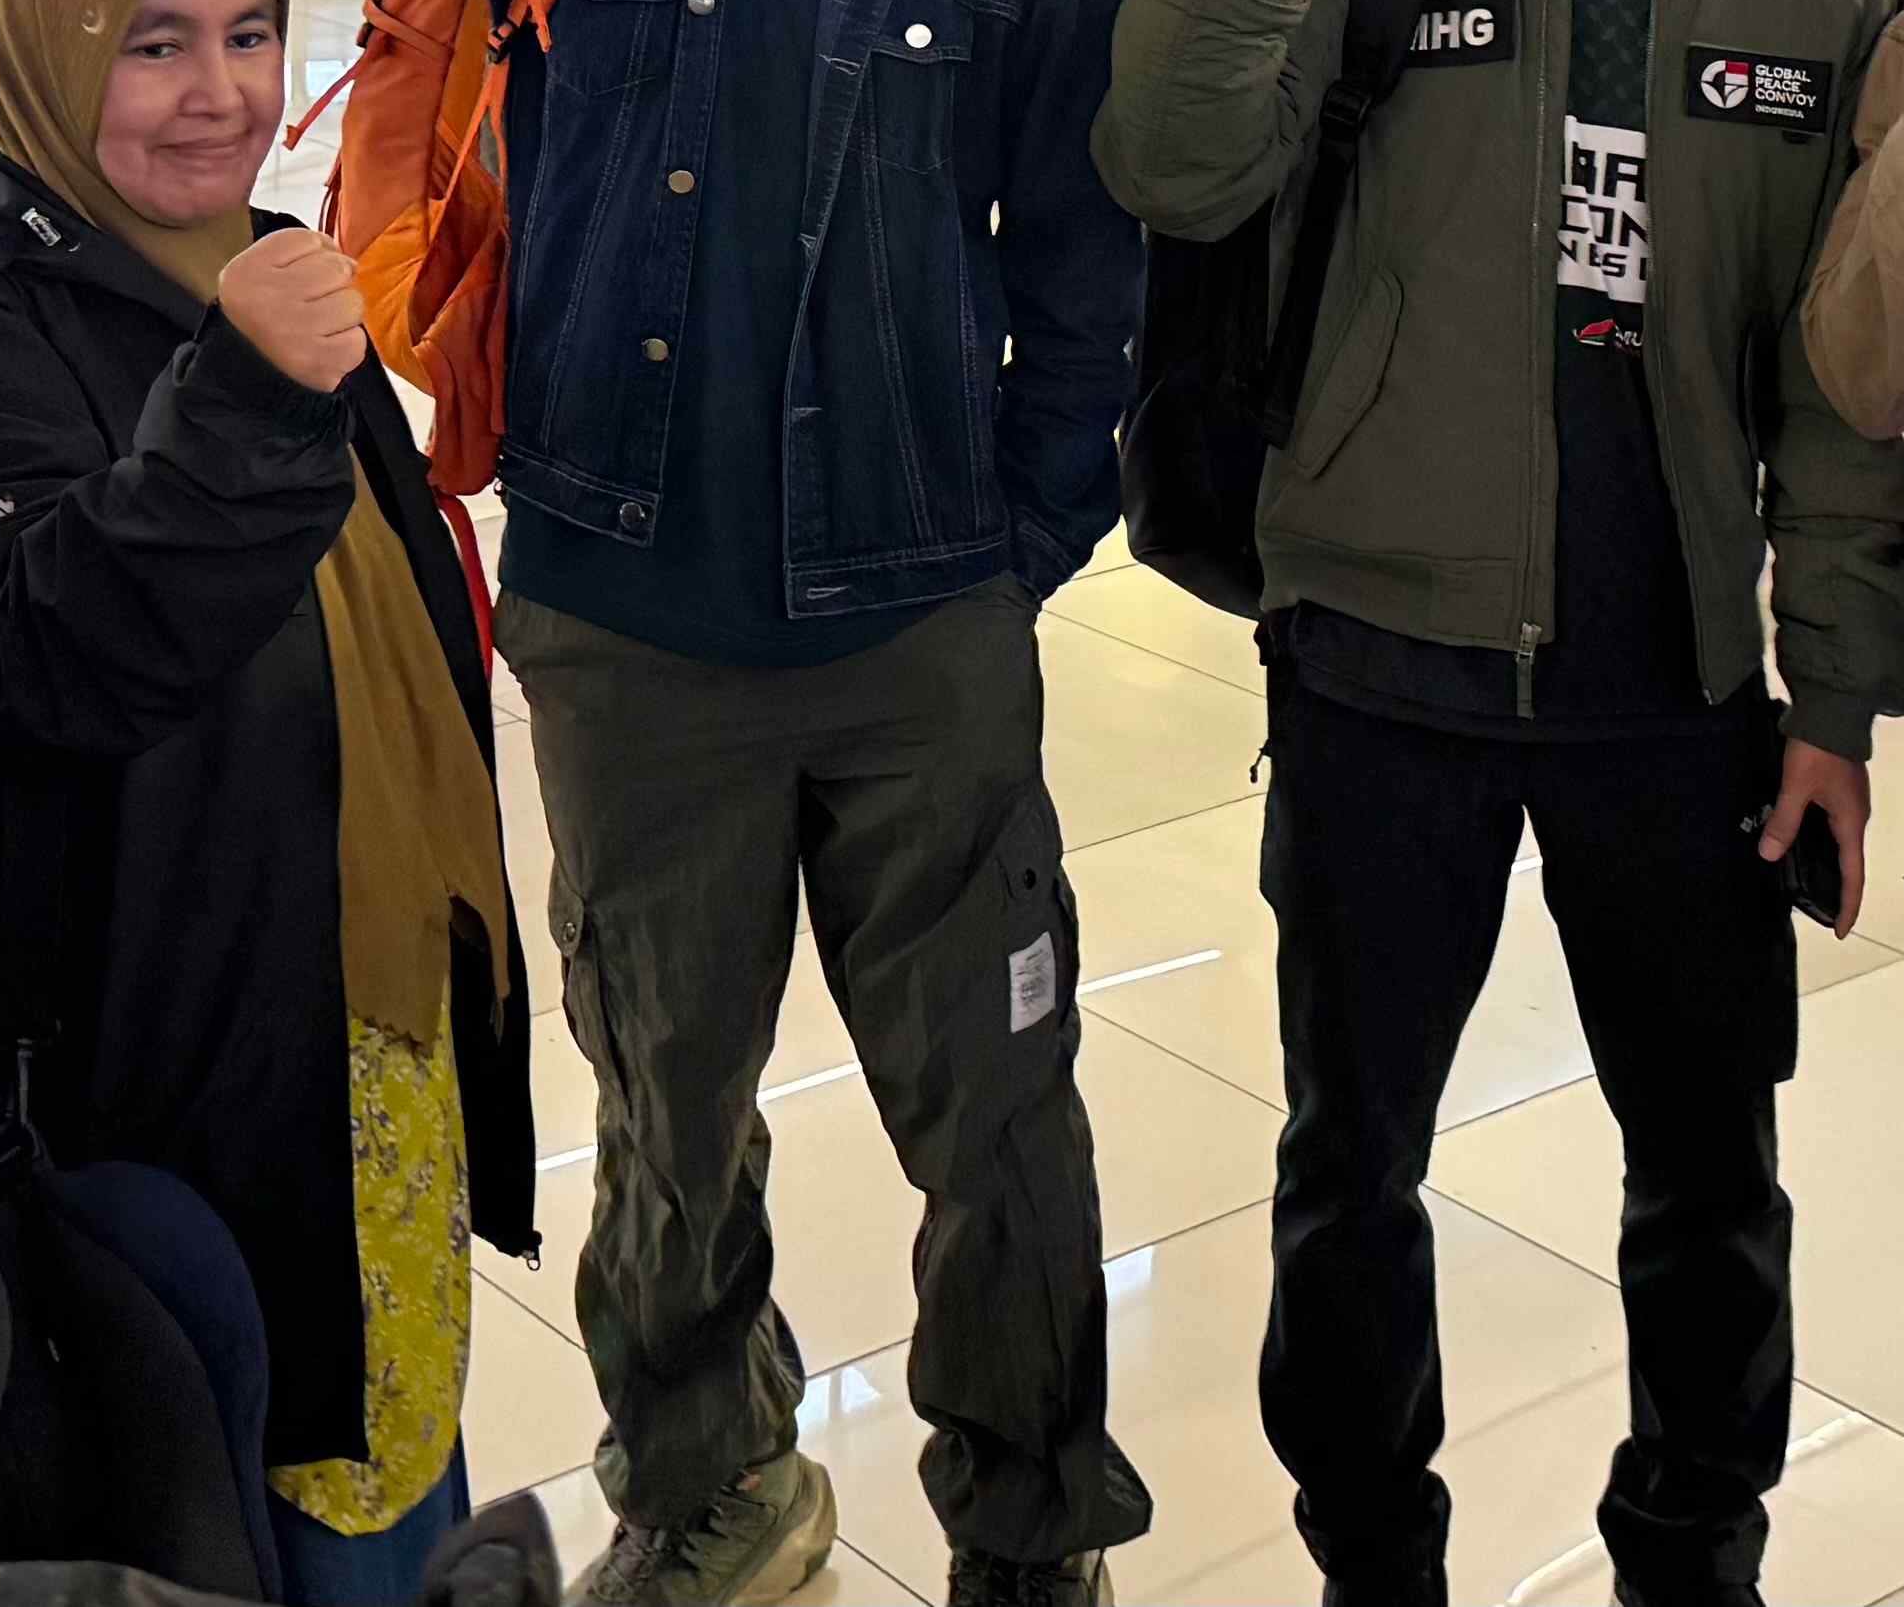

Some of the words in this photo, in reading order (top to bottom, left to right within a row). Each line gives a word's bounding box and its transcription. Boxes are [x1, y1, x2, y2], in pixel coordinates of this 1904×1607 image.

[1755, 64, 1812, 83] GLOBAL
[1755, 76, 1801, 93] PEACE
[1755, 87, 1817, 108] CONVOY
